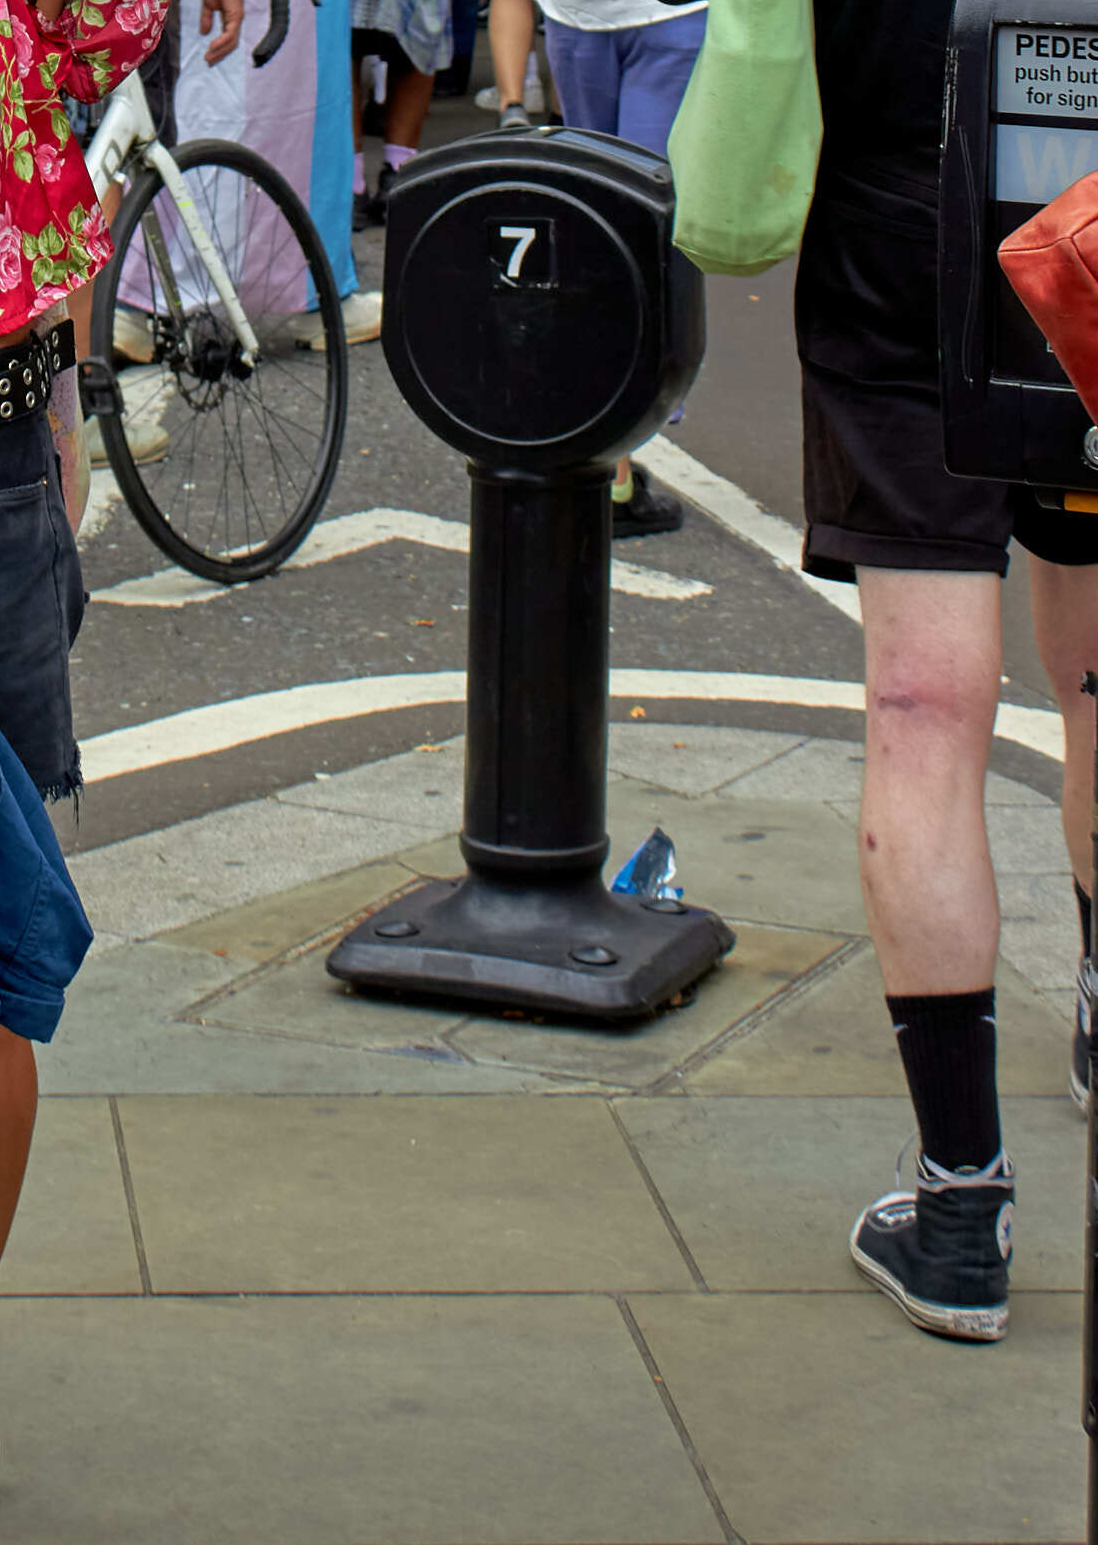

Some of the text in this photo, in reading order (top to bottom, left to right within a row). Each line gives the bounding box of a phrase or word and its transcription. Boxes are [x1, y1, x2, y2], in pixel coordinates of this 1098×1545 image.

[1014, 64, 1061, 84] push
[1026, 86, 1098, 111] for sign
[499, 225, 537, 279] 7
